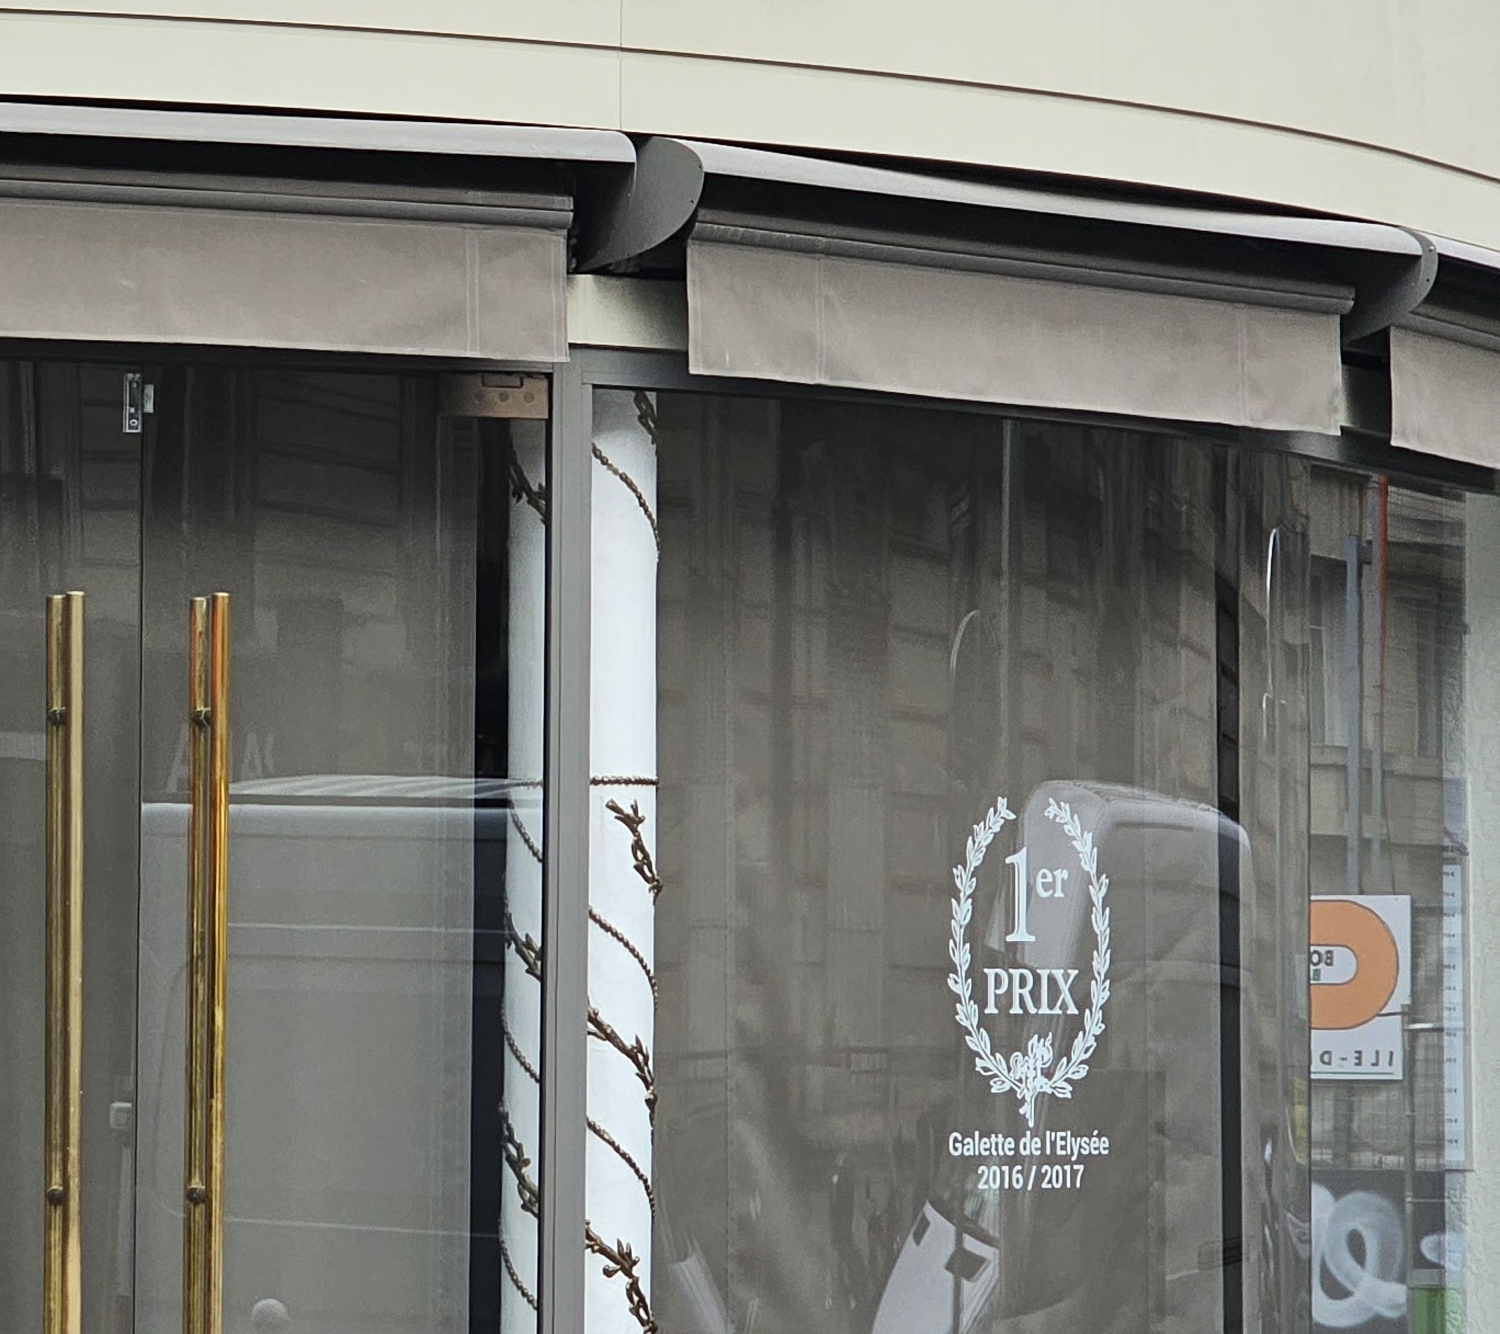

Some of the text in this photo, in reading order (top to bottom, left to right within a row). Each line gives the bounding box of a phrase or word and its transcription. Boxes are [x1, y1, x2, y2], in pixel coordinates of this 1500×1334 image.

[1005, 847, 1068, 942] 1er
[983, 968, 1079, 1015] PRIX
[948, 1130, 1109, 1161] Galette de l'Elysée
[977, 1165, 1023, 1190] 2016
[1040, 1164, 1085, 1189] 2017
